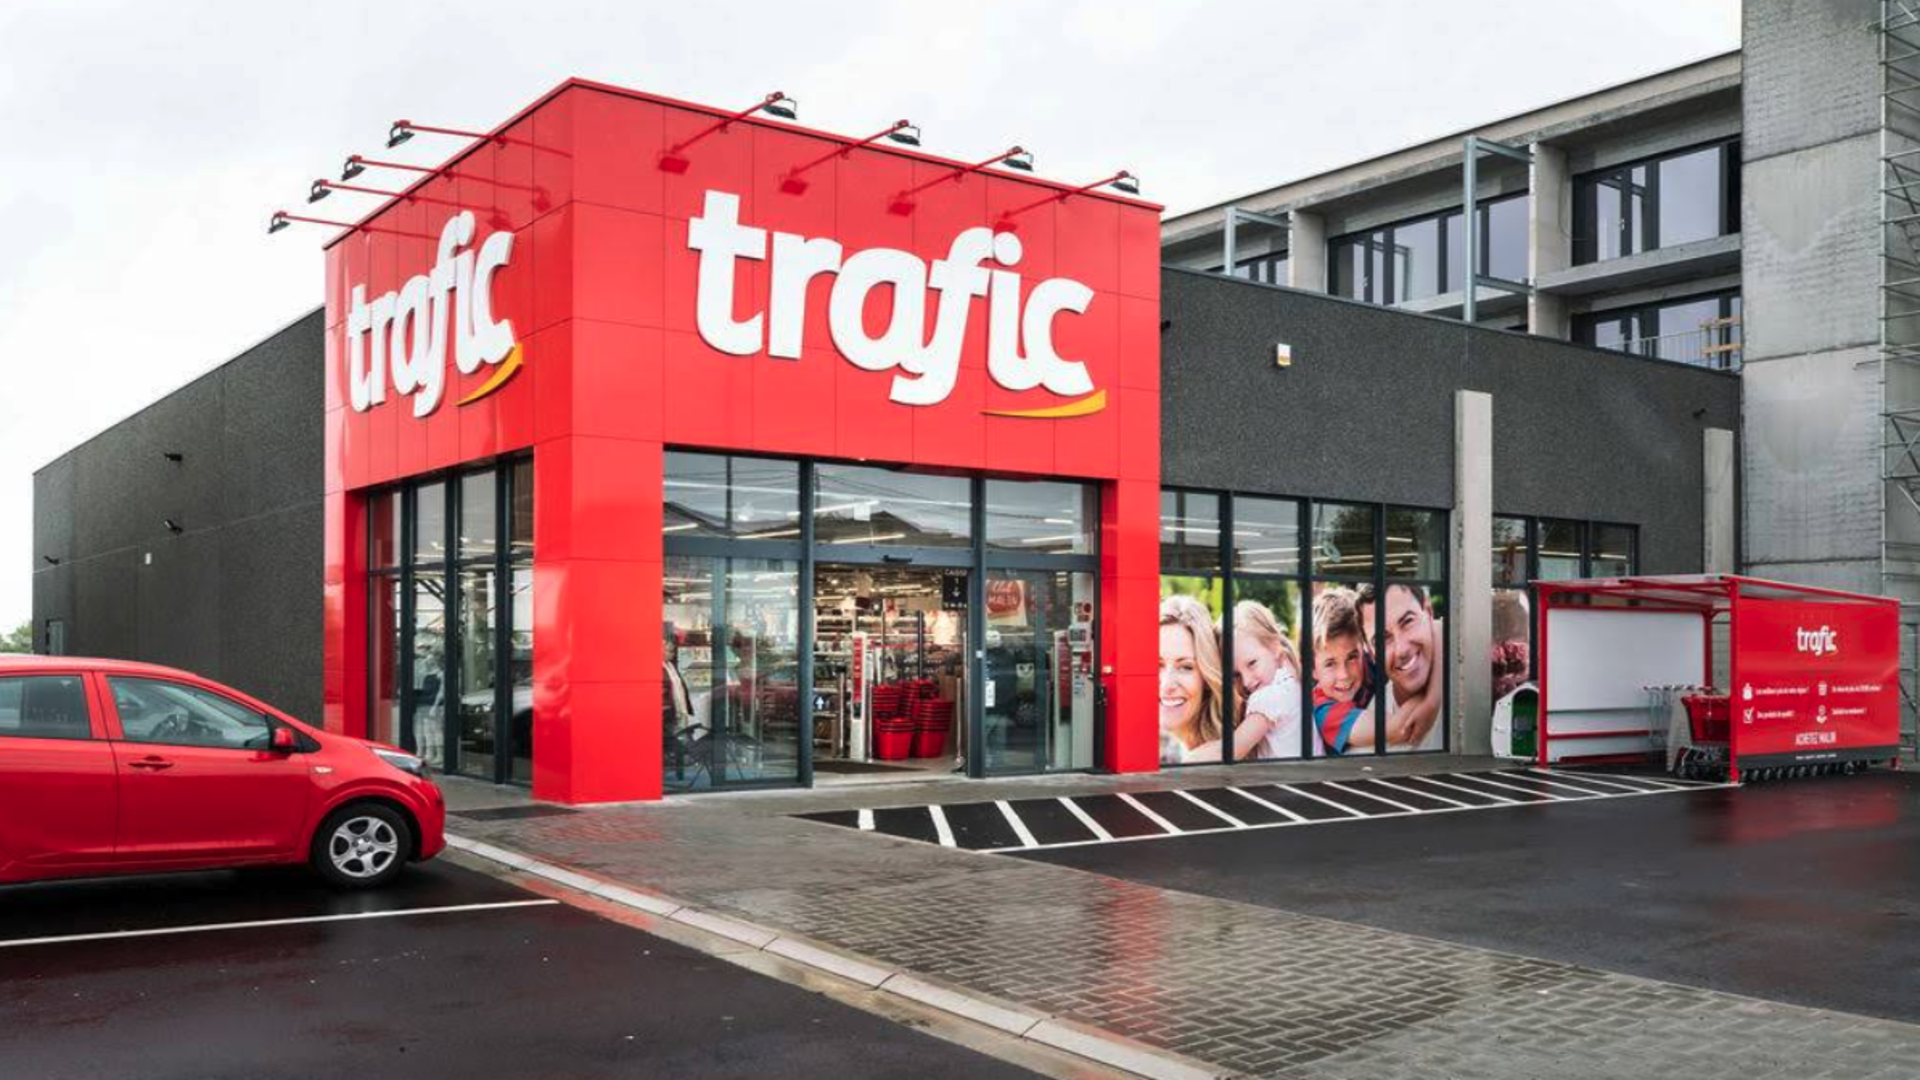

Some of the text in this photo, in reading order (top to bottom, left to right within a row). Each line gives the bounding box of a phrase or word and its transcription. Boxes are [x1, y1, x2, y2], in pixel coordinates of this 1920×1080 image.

[348, 210, 515, 418] trafic
[688, 189, 1096, 406] trafic
[1796, 624, 1838, 657] trafic
